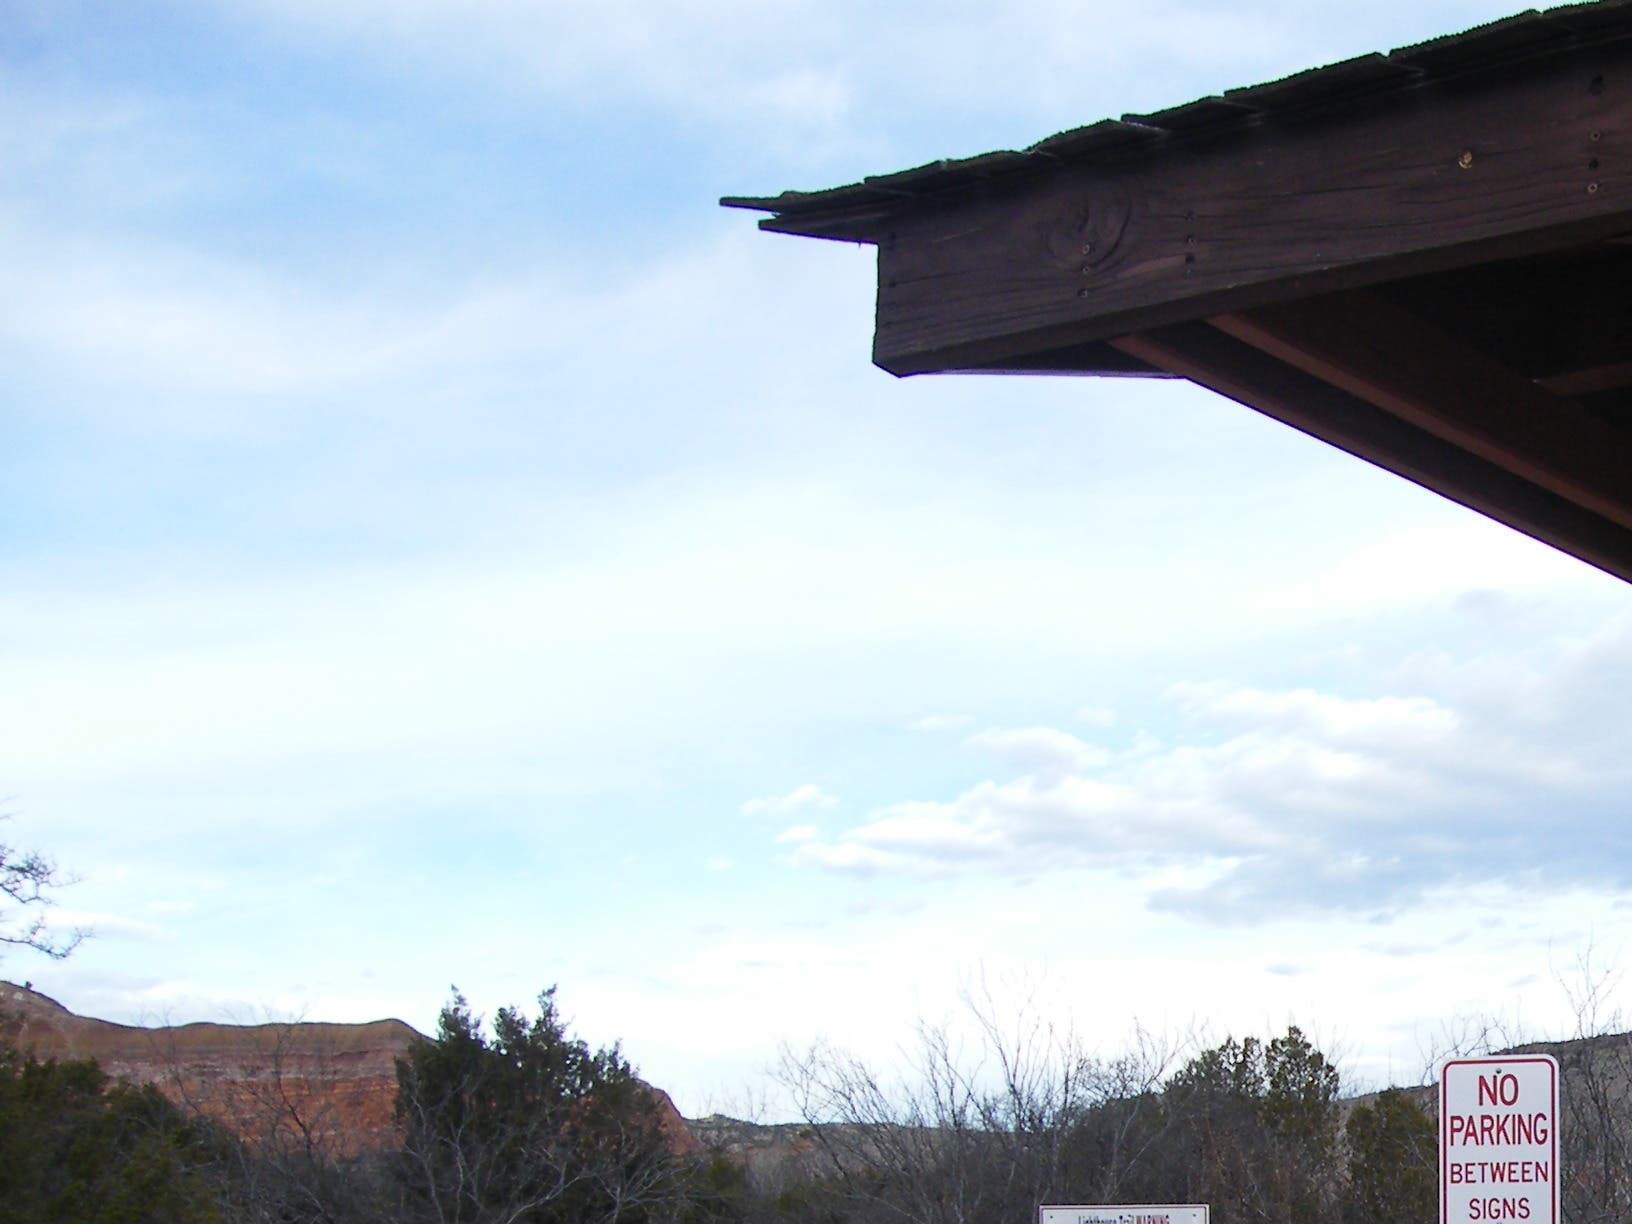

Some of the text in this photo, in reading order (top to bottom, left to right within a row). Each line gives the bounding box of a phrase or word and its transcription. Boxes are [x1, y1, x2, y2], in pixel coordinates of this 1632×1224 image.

[1478, 1073, 1520, 1107] NO
[1450, 1112, 1549, 1147] PARKING
[1450, 1161, 1549, 1185] BETWEEN
[1468, 1197, 1531, 1221] SIGNS
